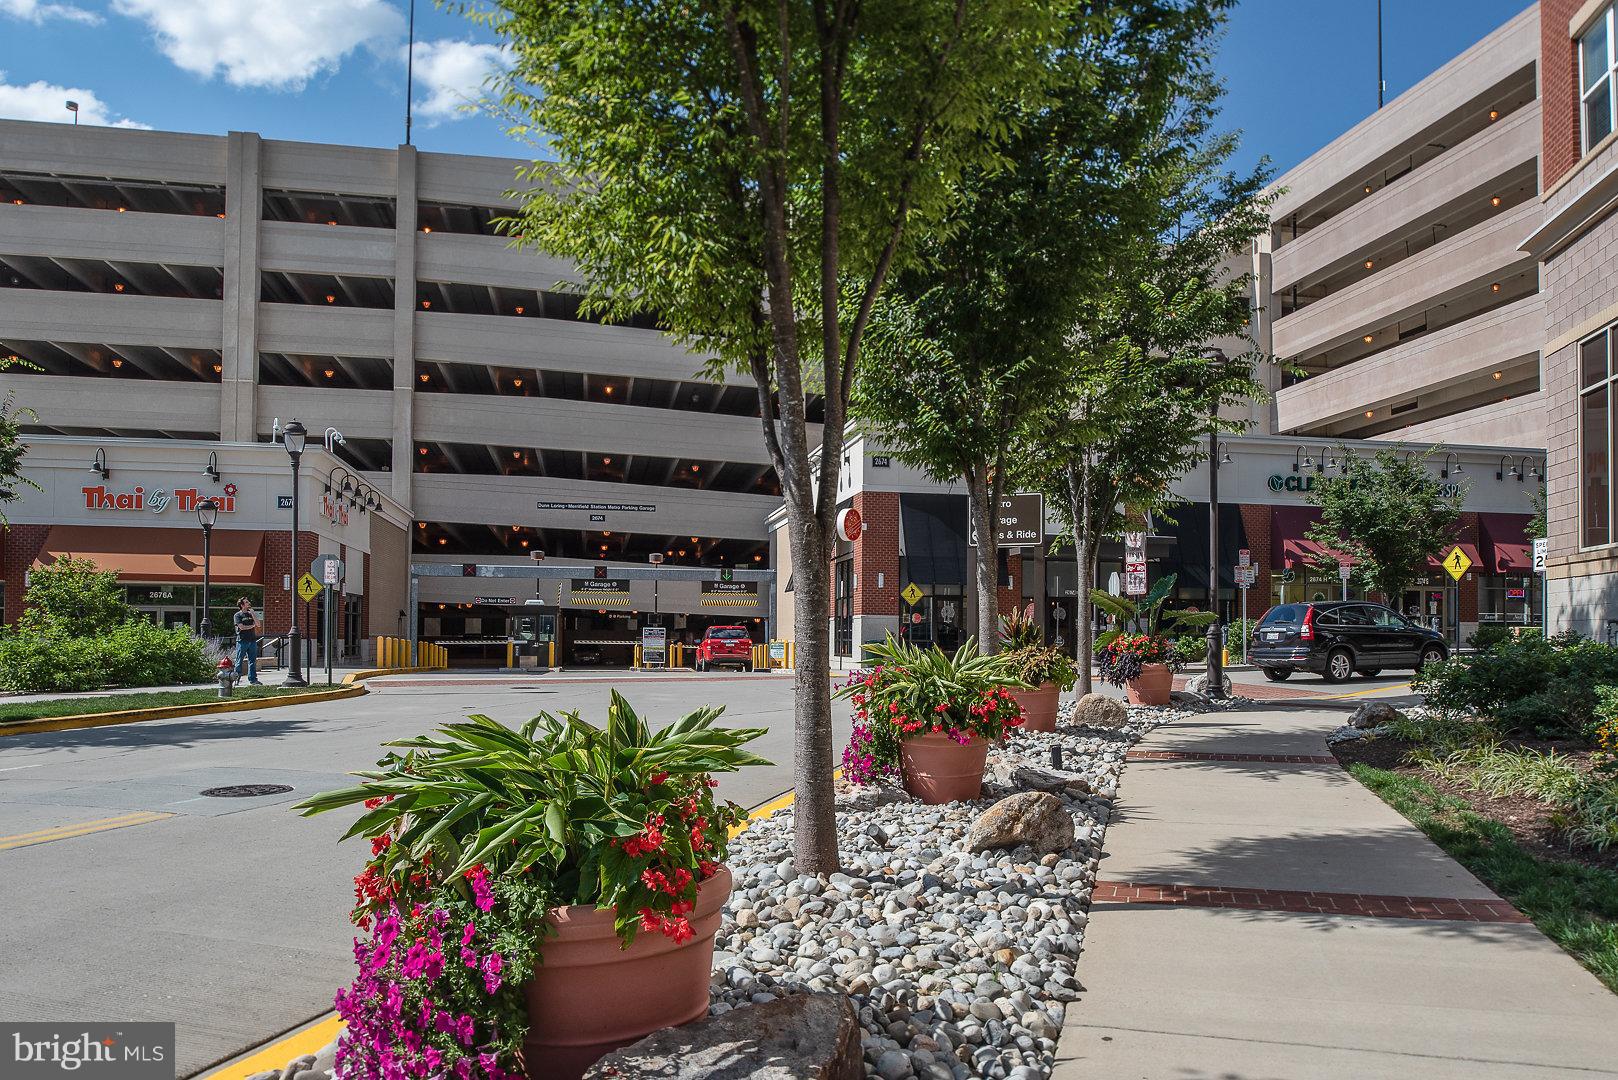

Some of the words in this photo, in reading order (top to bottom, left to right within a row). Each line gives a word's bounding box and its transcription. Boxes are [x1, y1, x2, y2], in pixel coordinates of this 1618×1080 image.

[82, 486, 144, 509] Thai
[148, 488, 171, 514] by
[174, 484, 236, 512] Thai
[280, 498, 294, 506] 267
[1006, 530, 1014, 538] &
[1016, 530, 1036, 538] Ride
